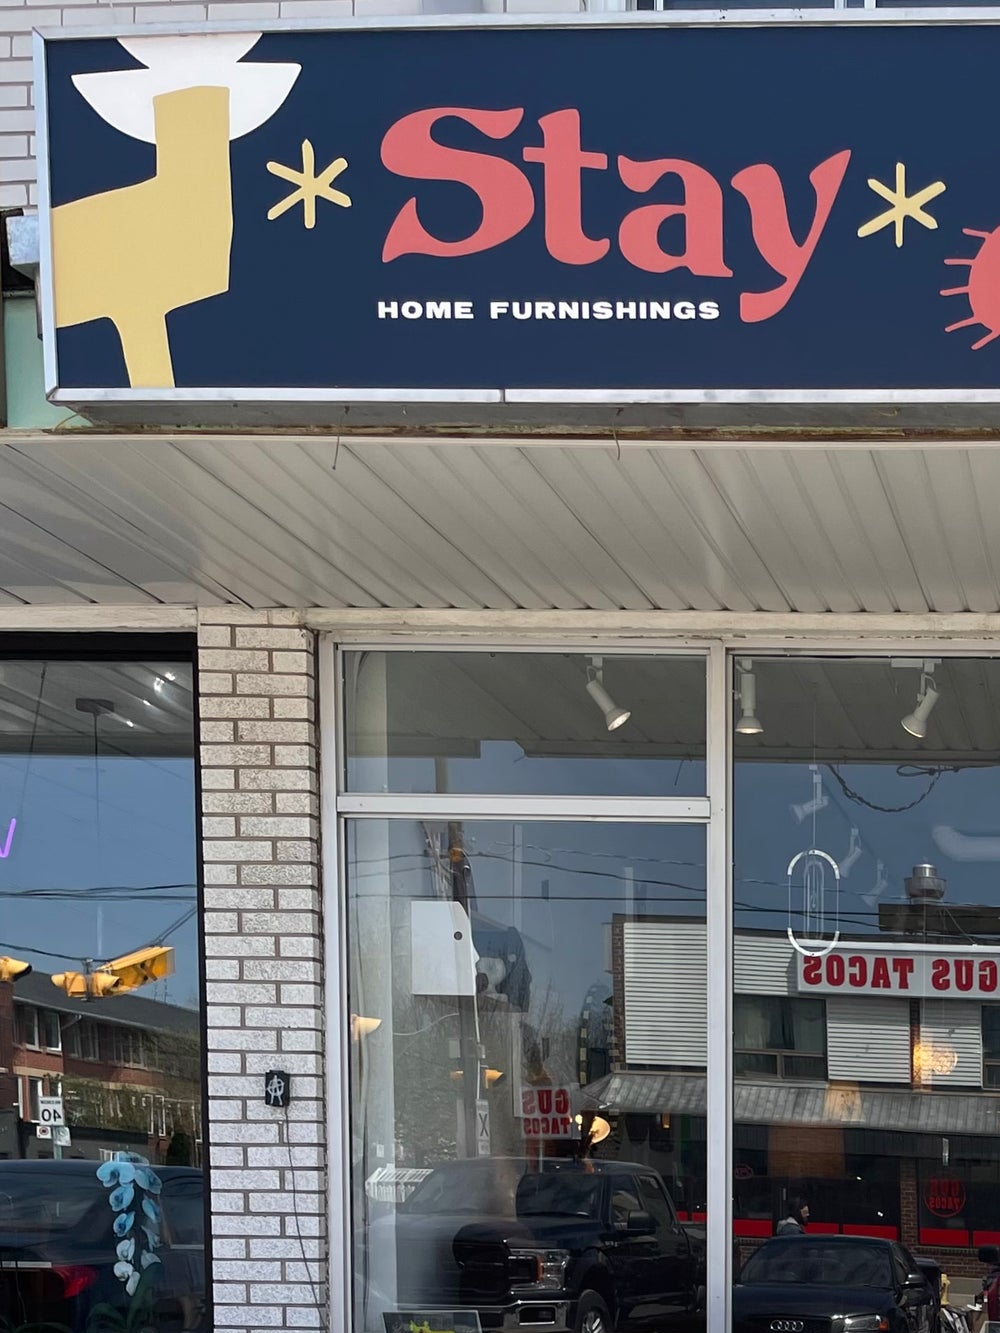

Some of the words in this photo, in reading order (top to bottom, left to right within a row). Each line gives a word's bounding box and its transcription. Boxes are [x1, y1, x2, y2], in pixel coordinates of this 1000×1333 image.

[380, 107, 851, 323] Stay
[377, 300, 474, 320] HOME
[490, 300, 720, 320] FURNISHINGS
